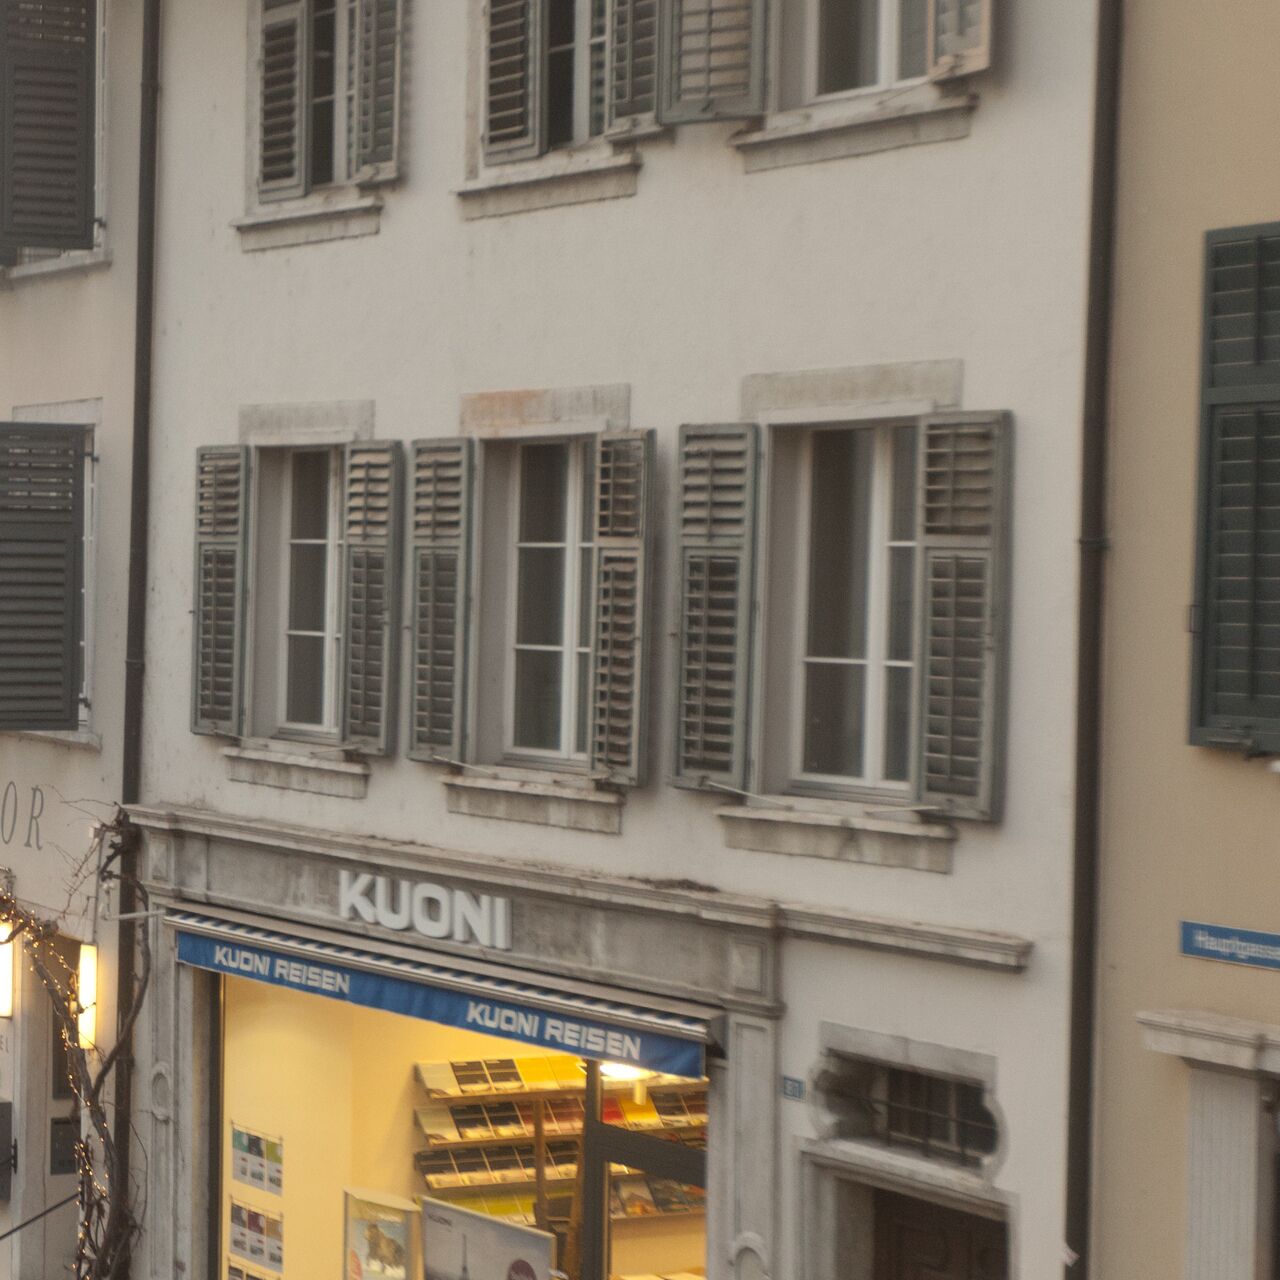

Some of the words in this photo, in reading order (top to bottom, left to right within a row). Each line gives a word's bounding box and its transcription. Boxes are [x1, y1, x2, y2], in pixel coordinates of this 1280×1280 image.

[338, 869, 511, 950] KUONI
[214, 944, 271, 977] KUONI
[274, 959, 351, 995] REISEN
[466, 1001, 540, 1039] KUONI
[543, 1017, 642, 1061] REISEN
